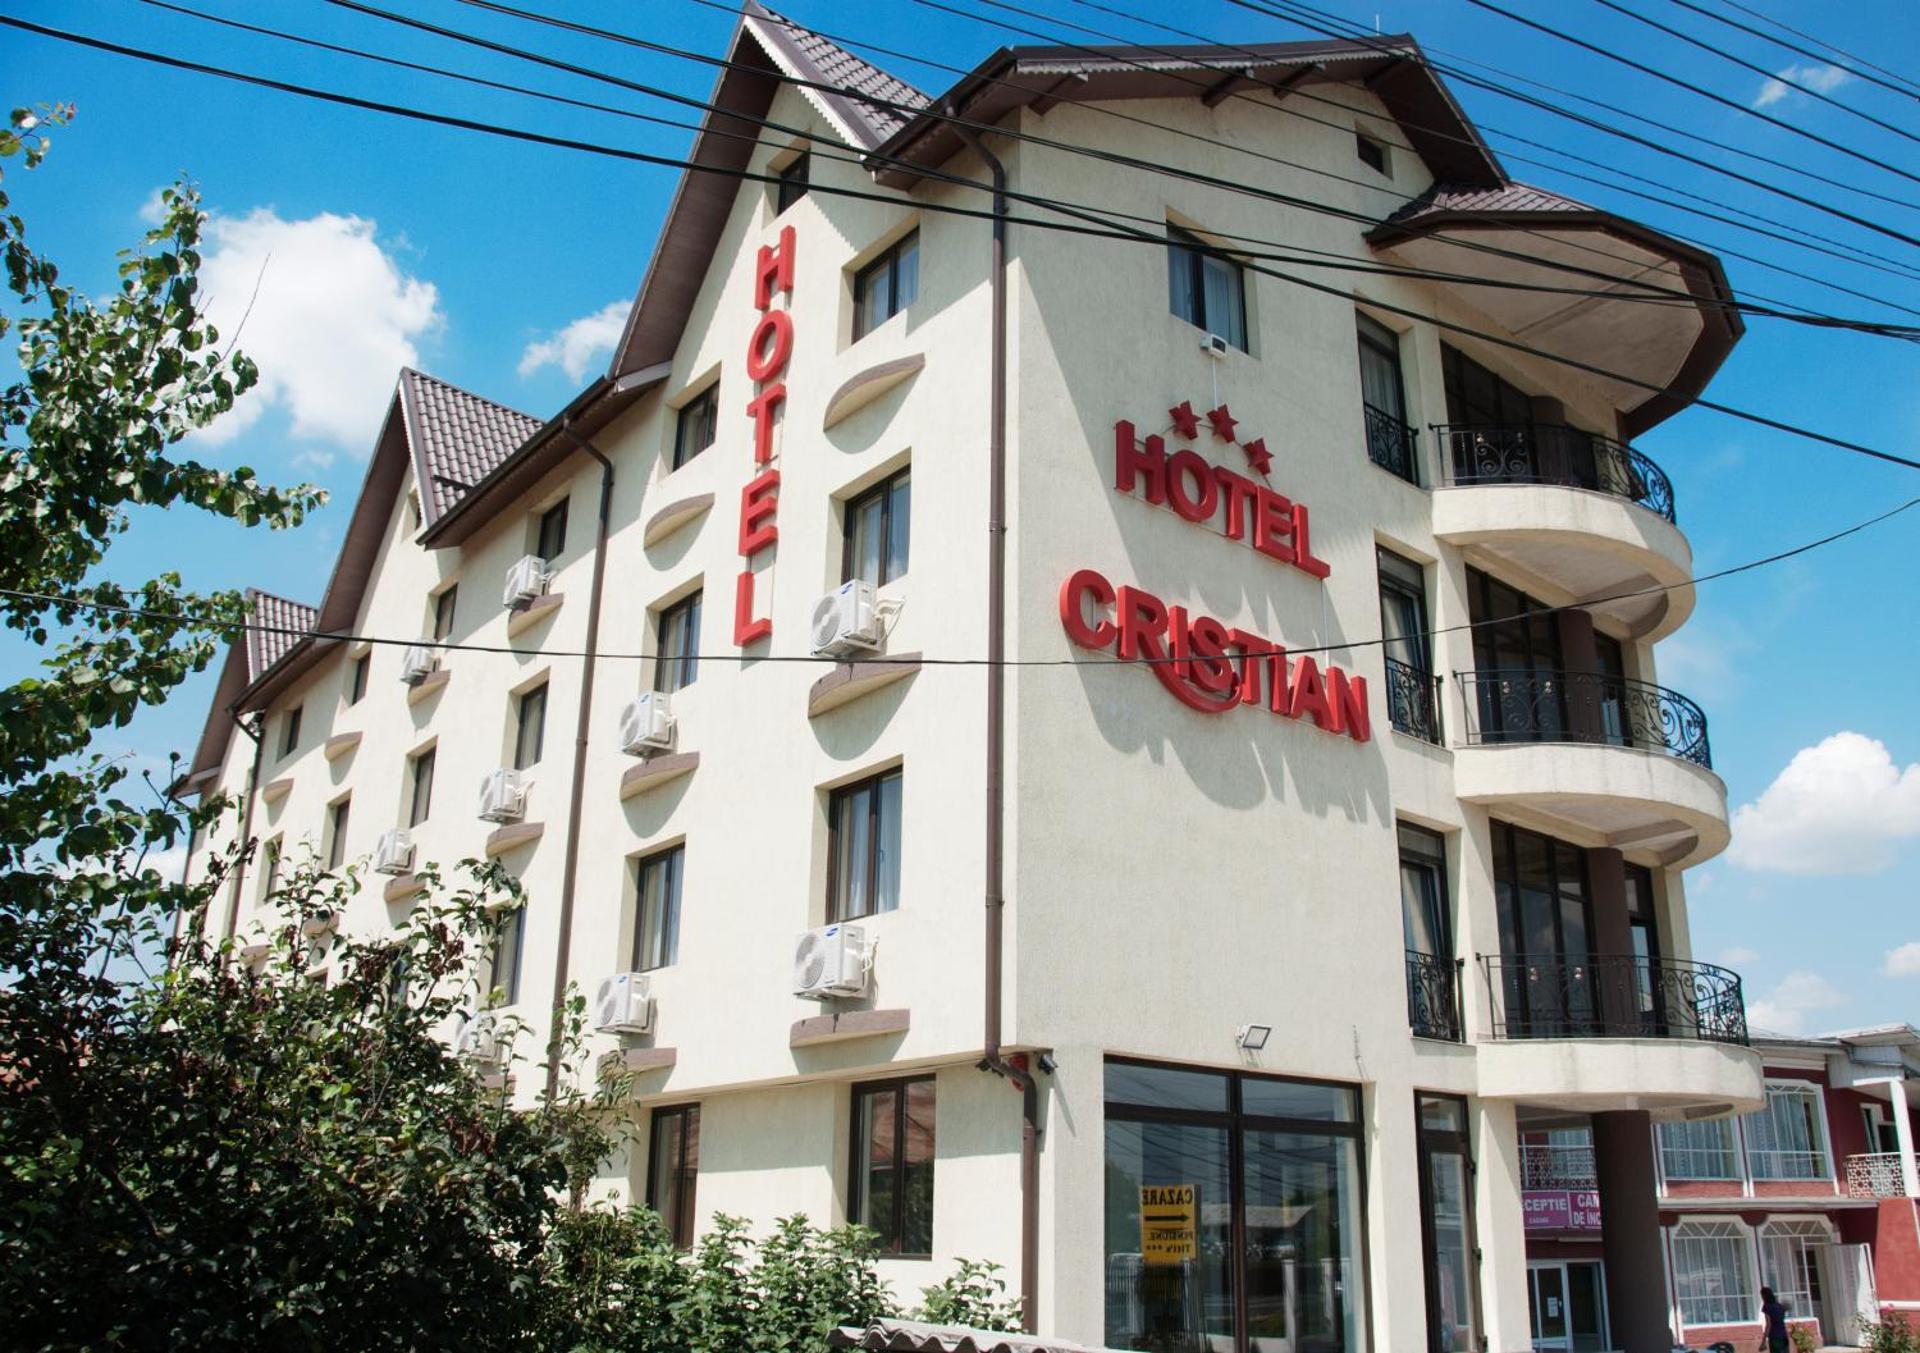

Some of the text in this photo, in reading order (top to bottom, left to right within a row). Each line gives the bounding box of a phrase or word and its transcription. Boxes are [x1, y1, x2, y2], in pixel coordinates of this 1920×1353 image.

[733, 224, 796, 648] HOTEL
[1115, 419, 1331, 580] HOTEL
[1059, 569, 1371, 743] CRISTIAN
[1522, 1198, 1567, 1212] CEPTIE
[1573, 1212, 1586, 1225] DE
